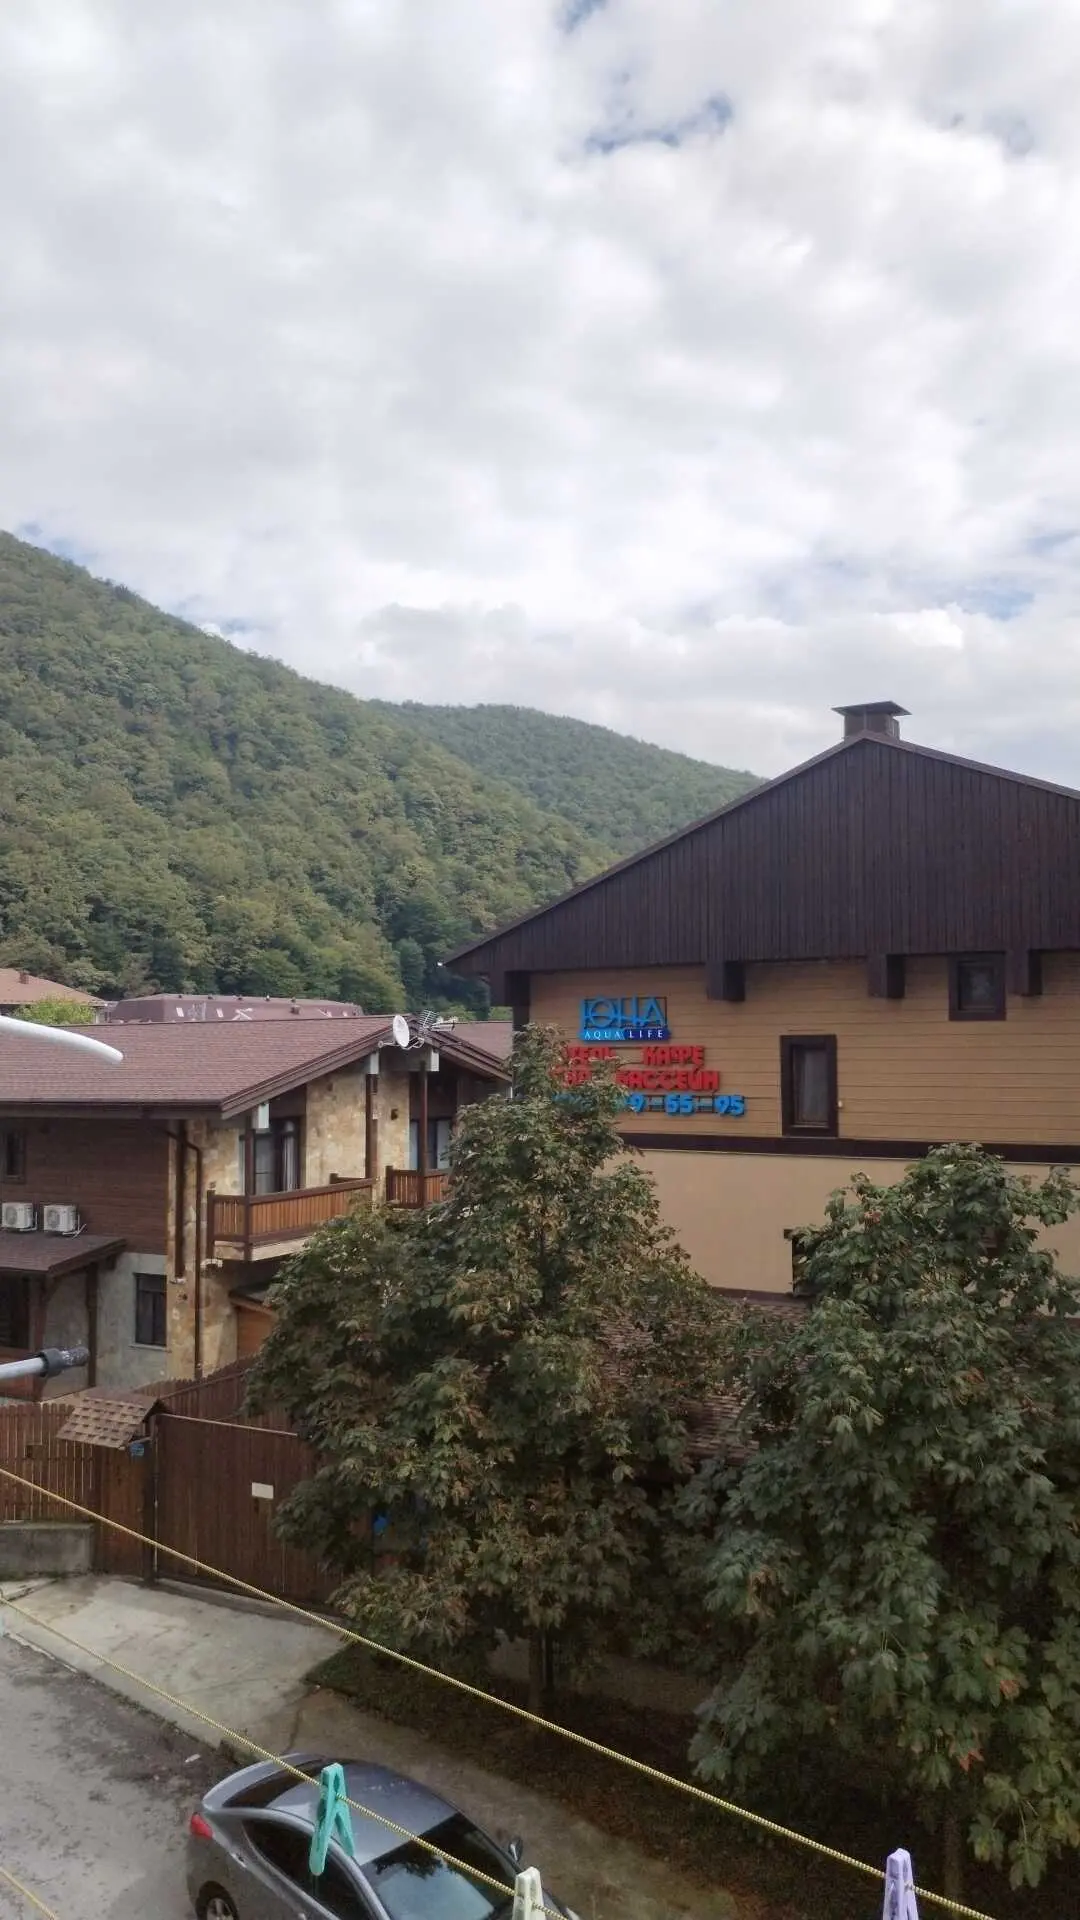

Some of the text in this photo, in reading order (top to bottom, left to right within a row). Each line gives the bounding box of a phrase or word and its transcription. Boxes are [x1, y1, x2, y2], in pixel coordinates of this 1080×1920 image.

[584, 1029, 663, 1040] AQUA LIFE
[642, 1045, 704, 1066] КАФЕ
